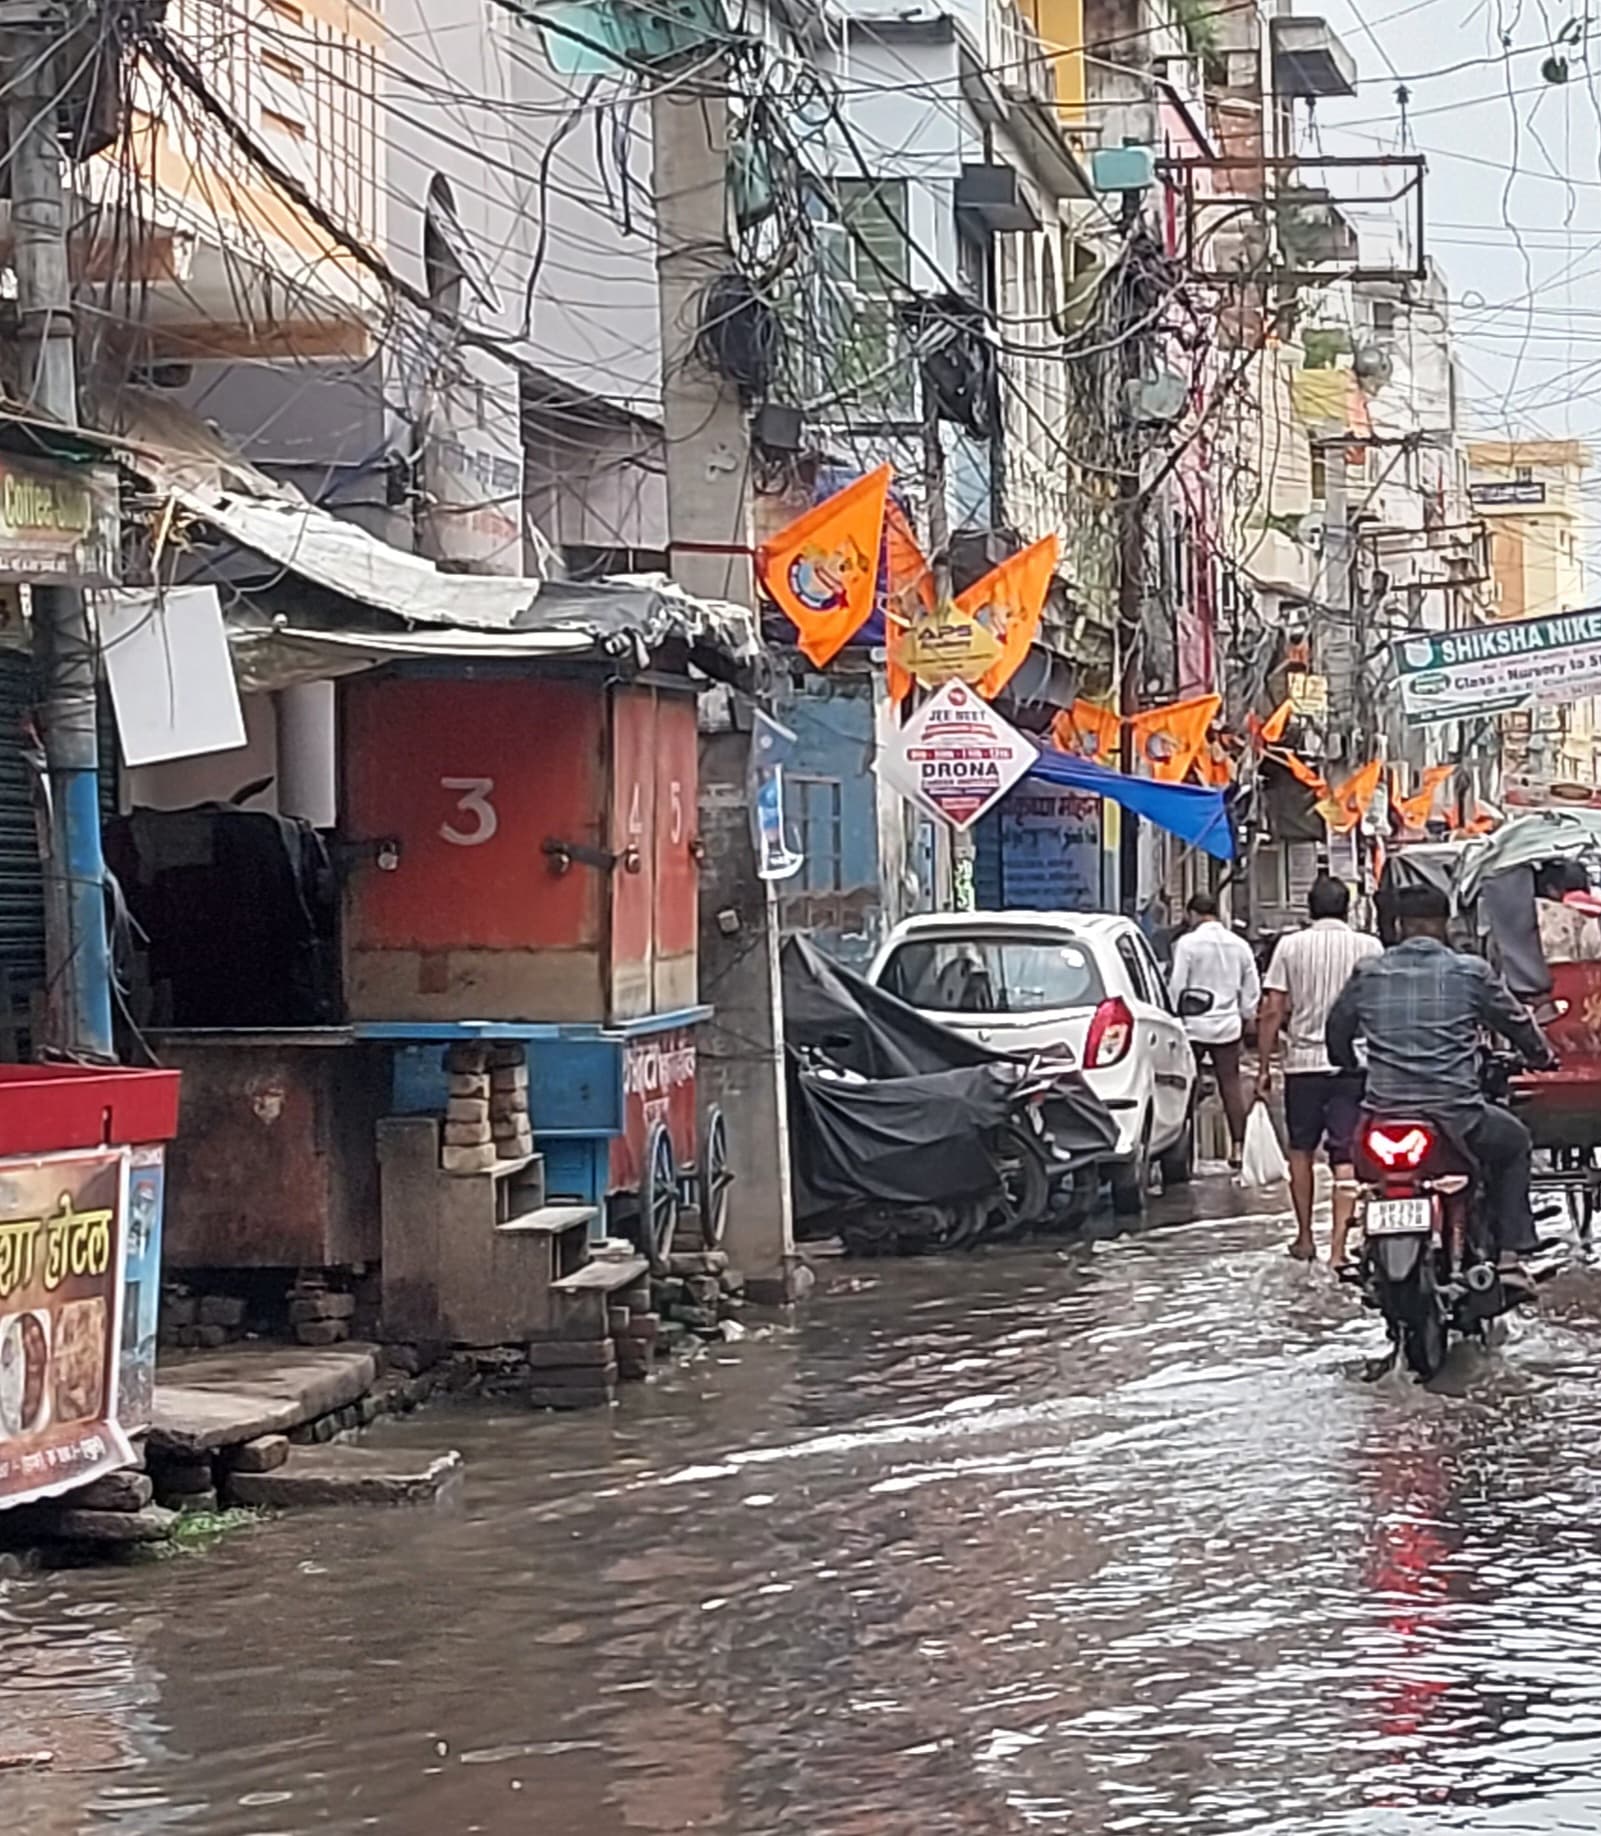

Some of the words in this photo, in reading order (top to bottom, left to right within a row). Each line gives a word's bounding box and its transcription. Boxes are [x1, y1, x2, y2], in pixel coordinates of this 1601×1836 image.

[1441, 623, 1544, 664] SHIKSHA
[1507, 662, 1566, 681] Nursery
[921, 762, 999, 778] DRONA
[438, 777, 498, 847] 3
[669, 780, 682, 845] 5
[44, 1190, 114, 1292] होटल
